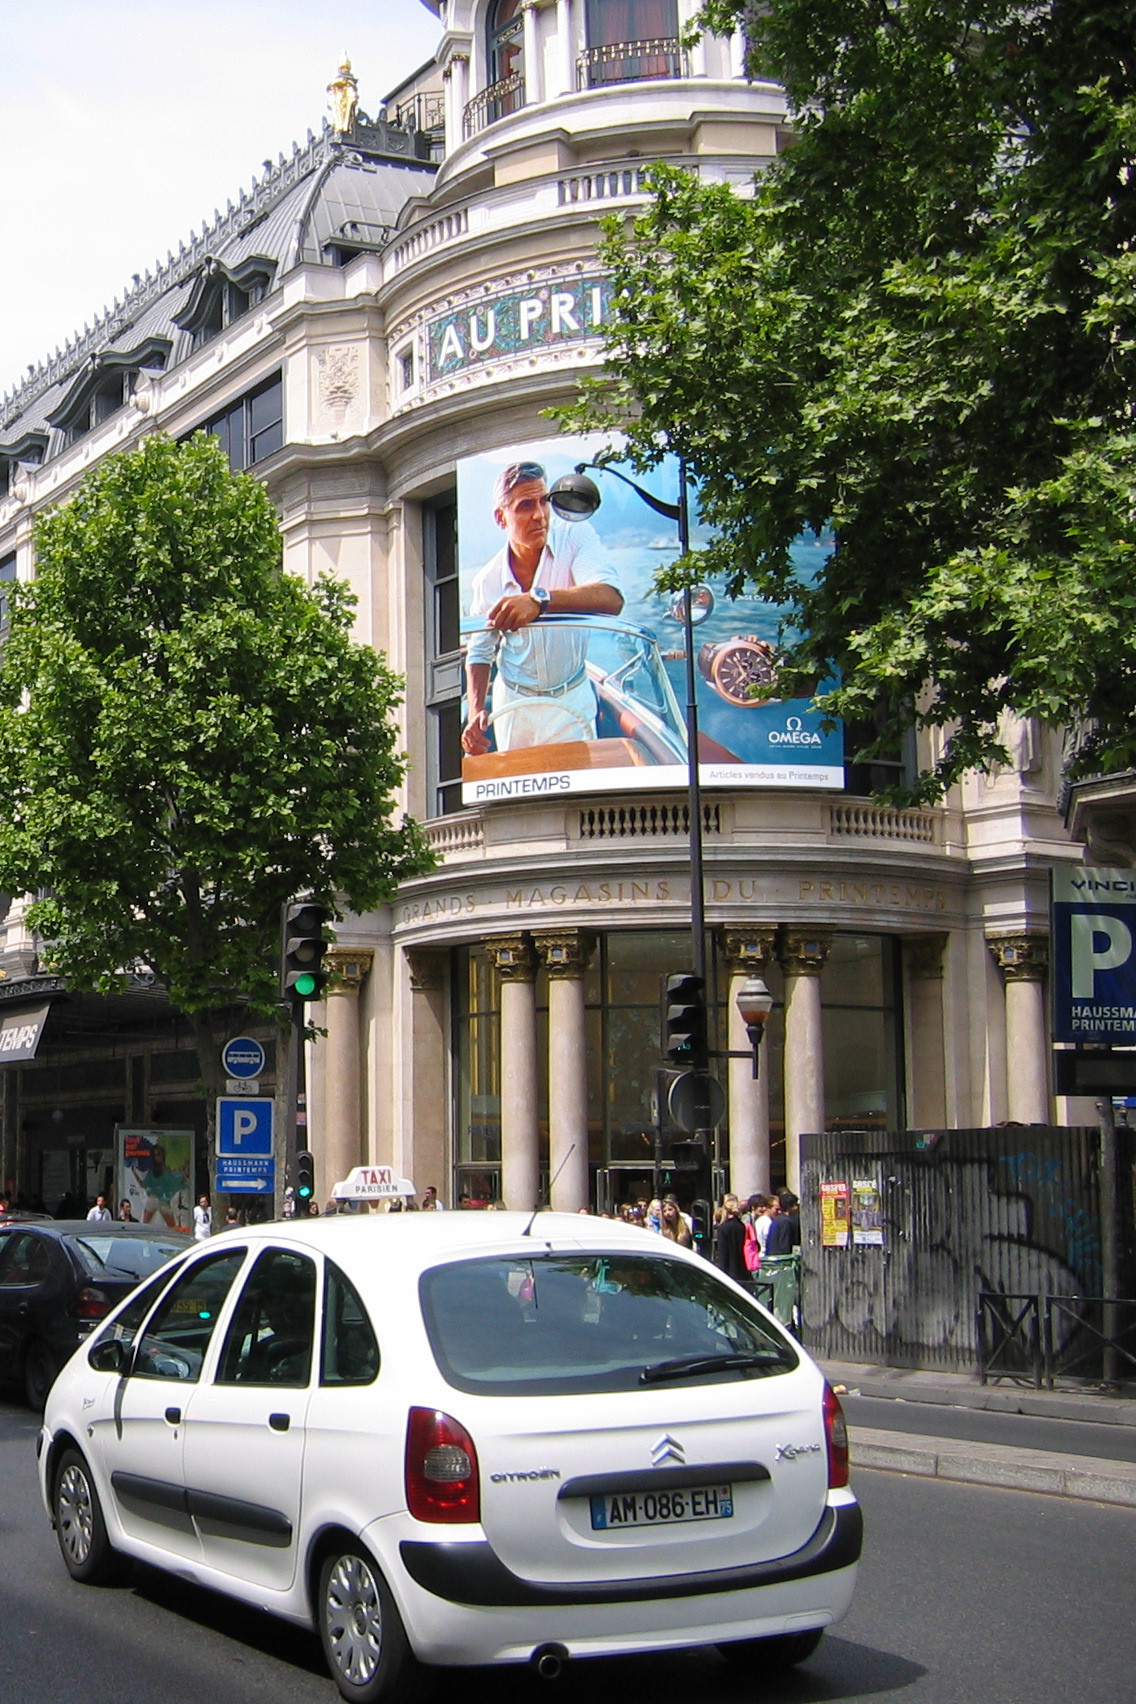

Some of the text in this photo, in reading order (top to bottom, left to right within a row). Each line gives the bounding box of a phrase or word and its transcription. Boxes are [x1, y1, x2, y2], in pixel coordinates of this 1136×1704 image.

[438, 286, 602, 369] AU PRI
[768, 731, 822, 744] OMEGA
[709, 770, 829, 782] Articles vendus au Printemps
[476, 775, 571, 799] PRINTEMPS
[1070, 880, 1135, 891] VINCI
[402, 879, 945, 925] GRANDS MAGASINS DU PRINTEMPS
[1070, 913, 1132, 999] P
[1071, 1019, 1136, 1031] PRINTEM
[234, 1110, 257, 1145] P
[361, 1169, 392, 1185] TAXI
[355, 1184, 399, 1194] PARISIEN
[720, 1501, 732, 1514] 75
